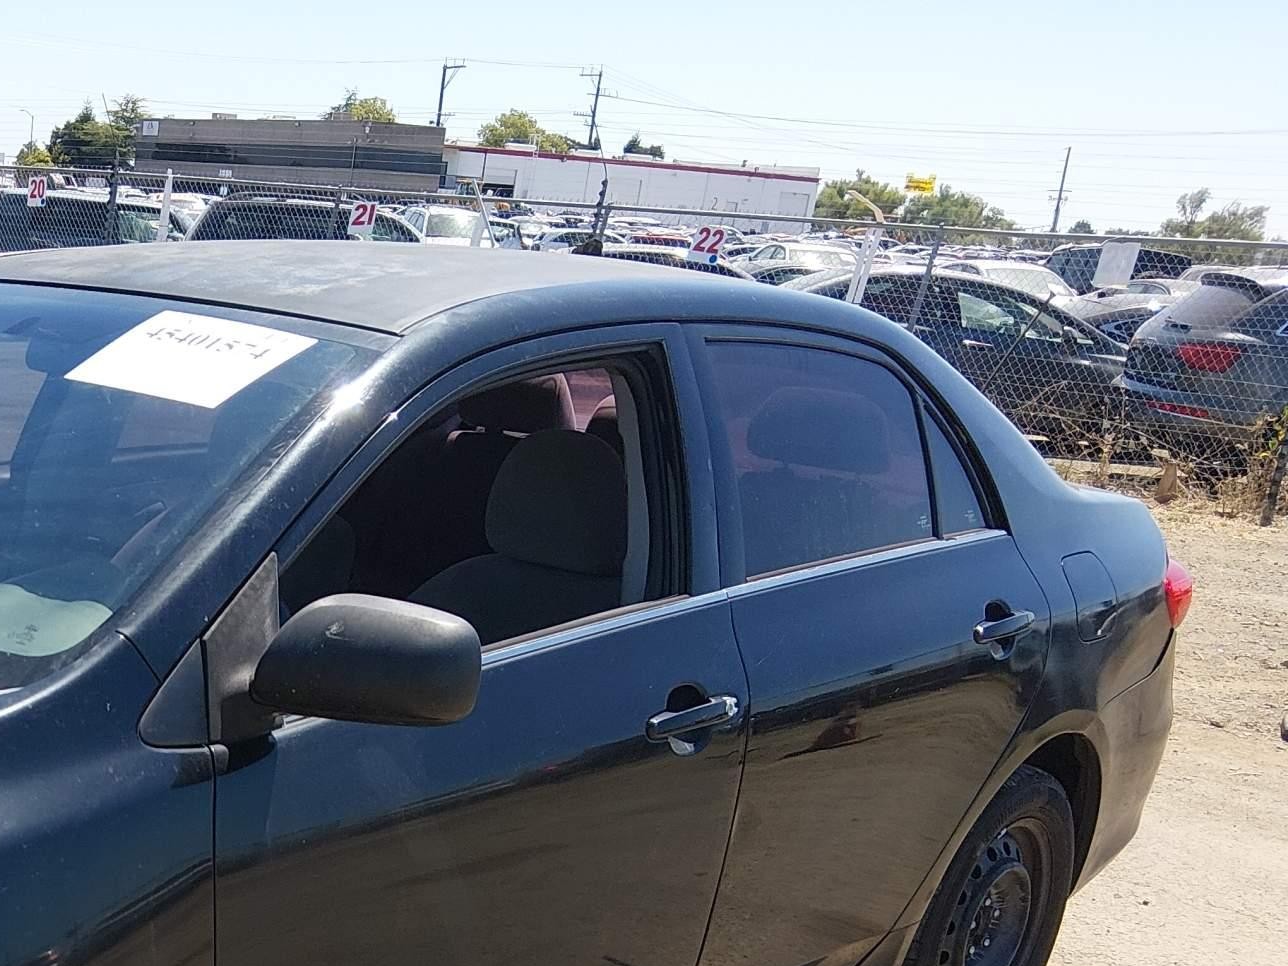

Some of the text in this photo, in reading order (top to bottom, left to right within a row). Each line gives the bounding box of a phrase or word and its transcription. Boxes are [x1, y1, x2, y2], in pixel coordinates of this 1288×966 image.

[29, 179, 45, 198] 20
[351, 203, 377, 226] 21
[692, 226, 725, 254] 22
